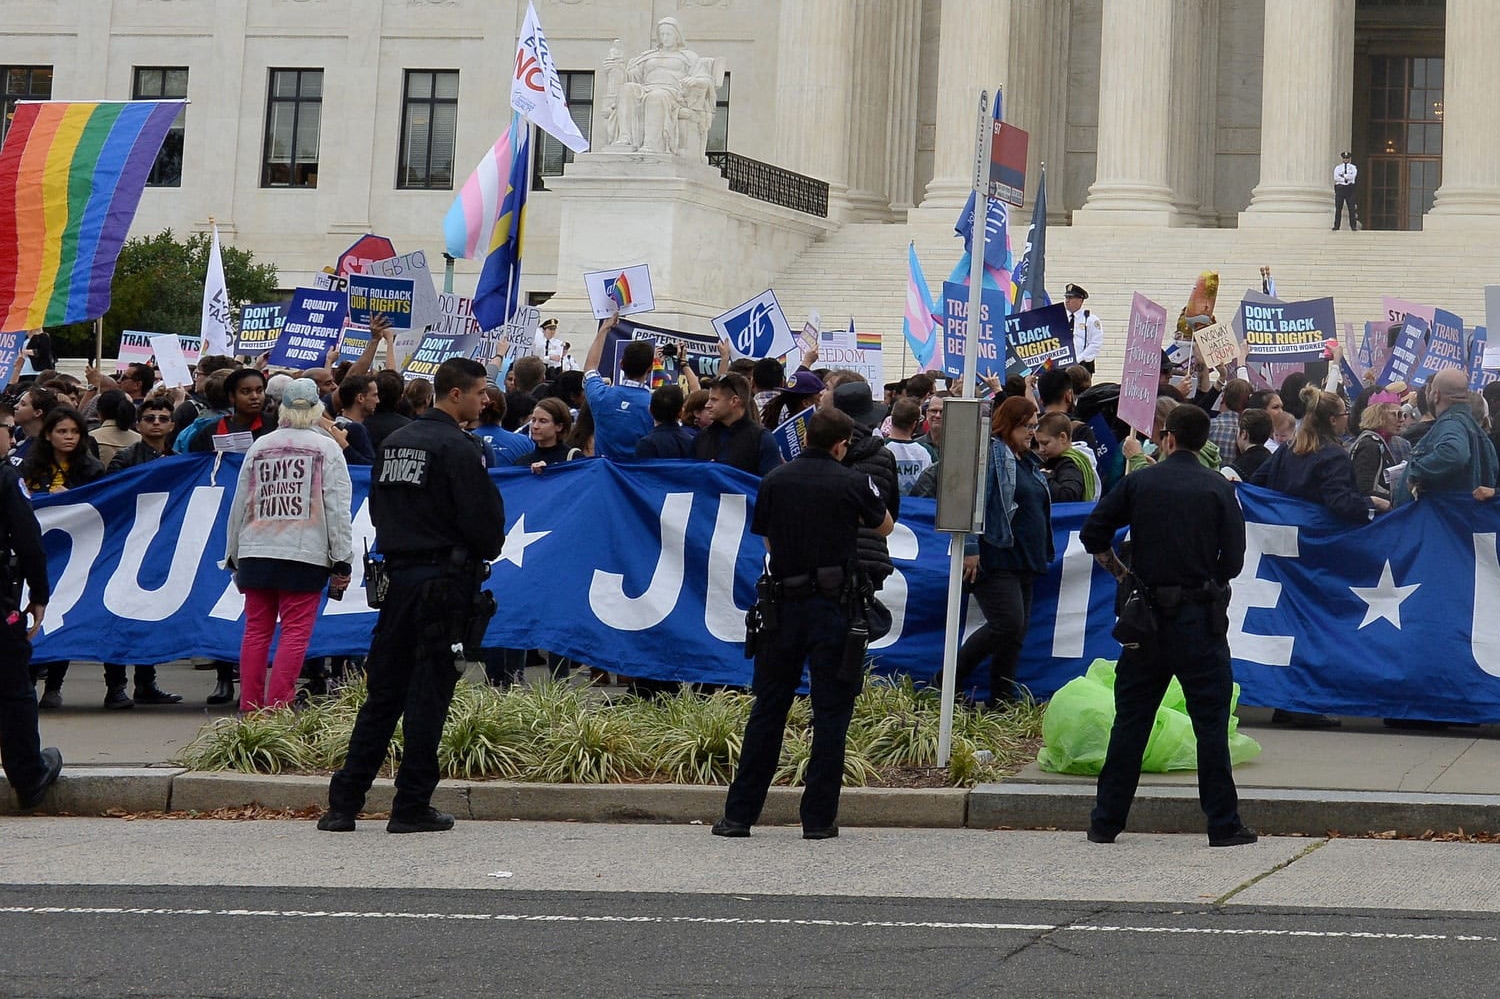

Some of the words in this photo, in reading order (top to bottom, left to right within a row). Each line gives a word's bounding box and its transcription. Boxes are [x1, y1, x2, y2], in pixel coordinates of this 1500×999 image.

[350, 286, 369, 298] DON'T
[369, 288, 411, 301] ROLLBACK
[245, 306, 281, 319] DON'T
[301, 299, 339, 312] EQUALITY
[350, 296, 367, 310] OUR
[370, 299, 411, 314] RIGHTS
[947, 299, 989, 321] TRAS
[1245, 305, 1284, 319] DON'T
[242, 318, 270, 330] ROLL
[308, 312, 324, 323] FOR
[1246, 318, 1277, 332] ROLL
[1280, 318, 1315, 332] BACK
[240, 330, 266, 341] OUR
[284, 322, 311, 336] LGBTQ
[310, 326, 339, 339] PEOPLE
[736, 302, 774, 358] aft
[947, 318, 994, 340] PEOLE
[1018, 325, 1051, 345] BACK
[1200, 324, 1229, 345] NORWAY
[1435, 323, 1459, 344] TRANS
[123, 334, 152, 347] TRAN
[288, 336, 302, 346] NO
[300, 337, 326, 350] MORE
[422, 337, 454, 350] DON'T
[1247, 331, 1273, 344] OUR
[1276, 330, 1323, 344] RIGHTS
[285, 348, 299, 358] NO
[298, 349, 319, 362] LESS
[947, 337, 997, 359] BELNG
[1015, 337, 1061, 358] RIGHTS
[1207, 343, 1236, 363] TRUMP
[1278, 344, 1298, 353] LGBTQ
[1429, 339, 1462, 361] PEOPLE
[415, 349, 442, 363] ROLL
[408, 361, 432, 373] OUR
[260, 457, 305, 483] GAYS
[260, 481, 304, 498] AGAINST
[259, 496, 303, 518] GUNS
